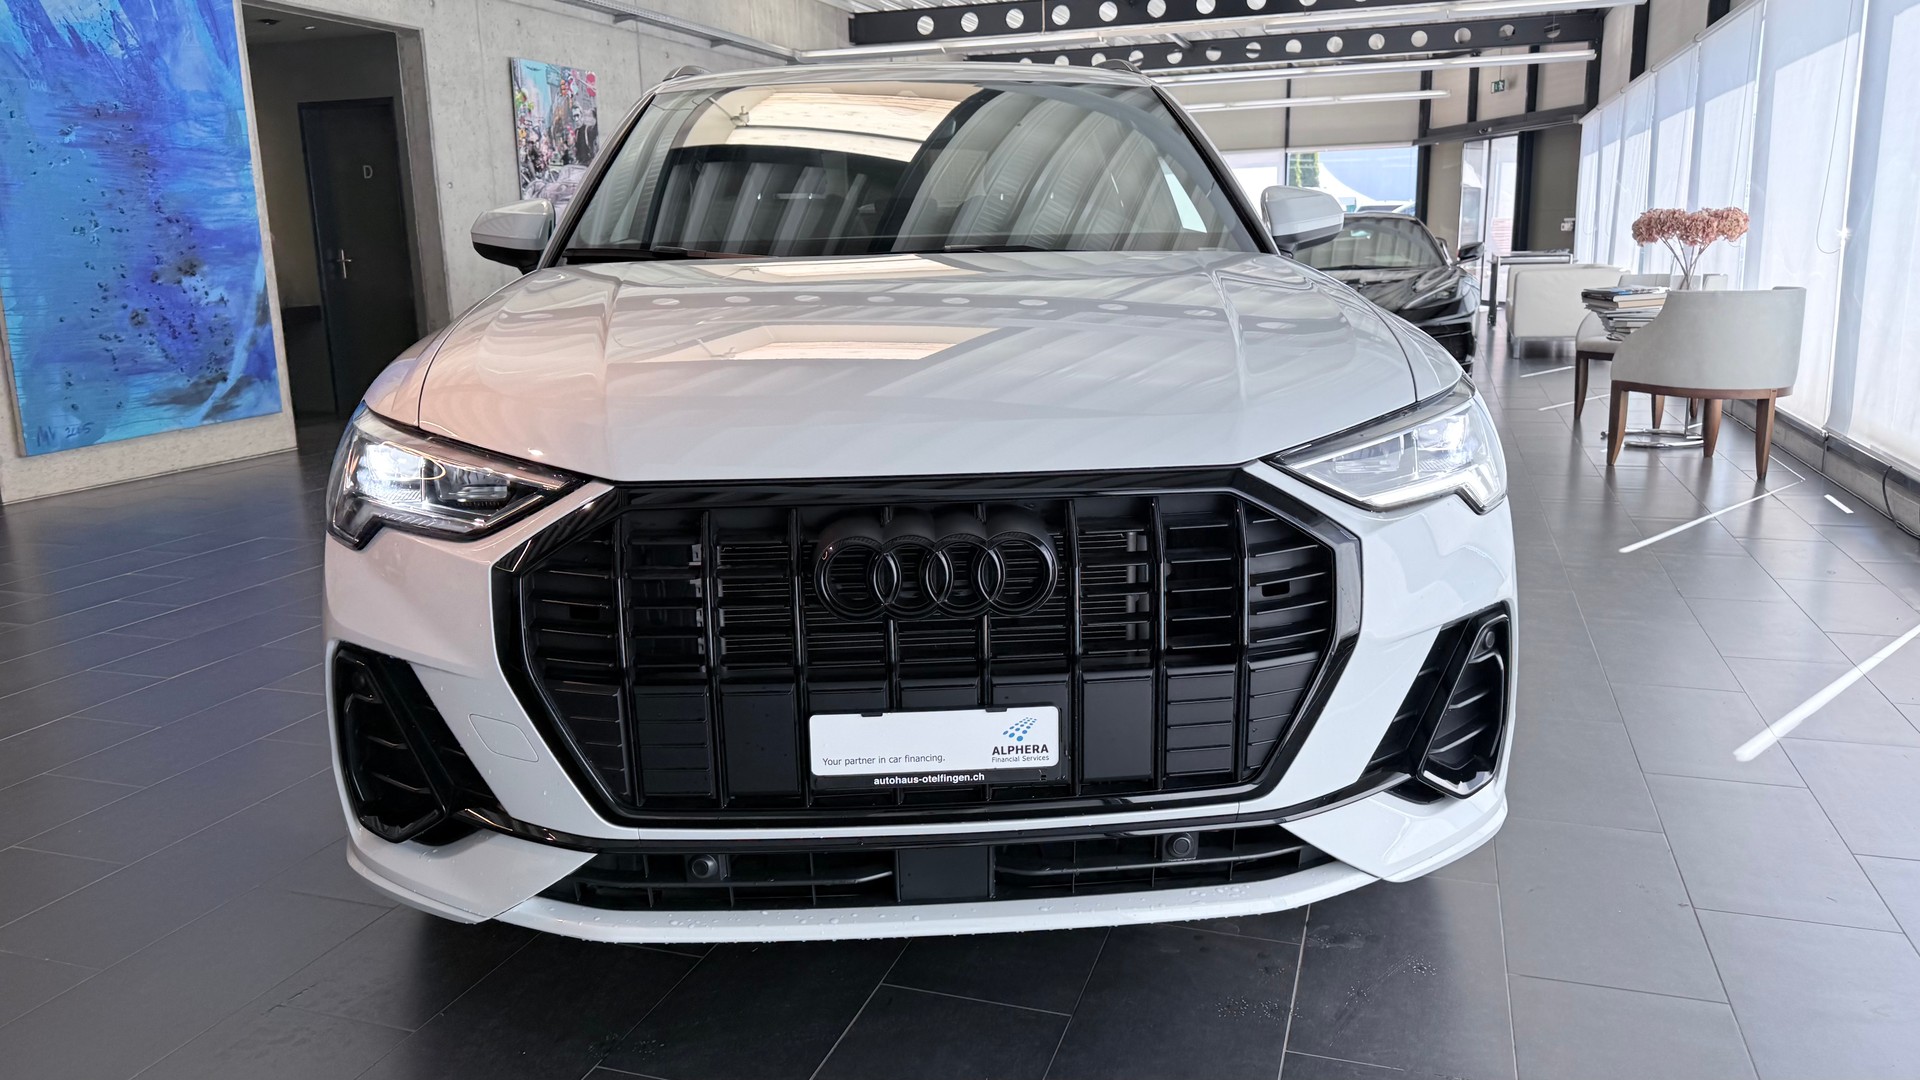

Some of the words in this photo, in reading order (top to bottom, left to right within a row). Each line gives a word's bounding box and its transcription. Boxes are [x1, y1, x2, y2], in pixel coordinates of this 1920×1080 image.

[363, 165, 373, 179] D
[992, 744, 1049, 755] ALPHERA
[822, 757, 841, 766] Your
[844, 756, 875, 767] partner
[878, 755, 886, 764] in
[904, 754, 945, 763] financing.
[873, 772, 985, 785] autohaus-otelfingen.ch
